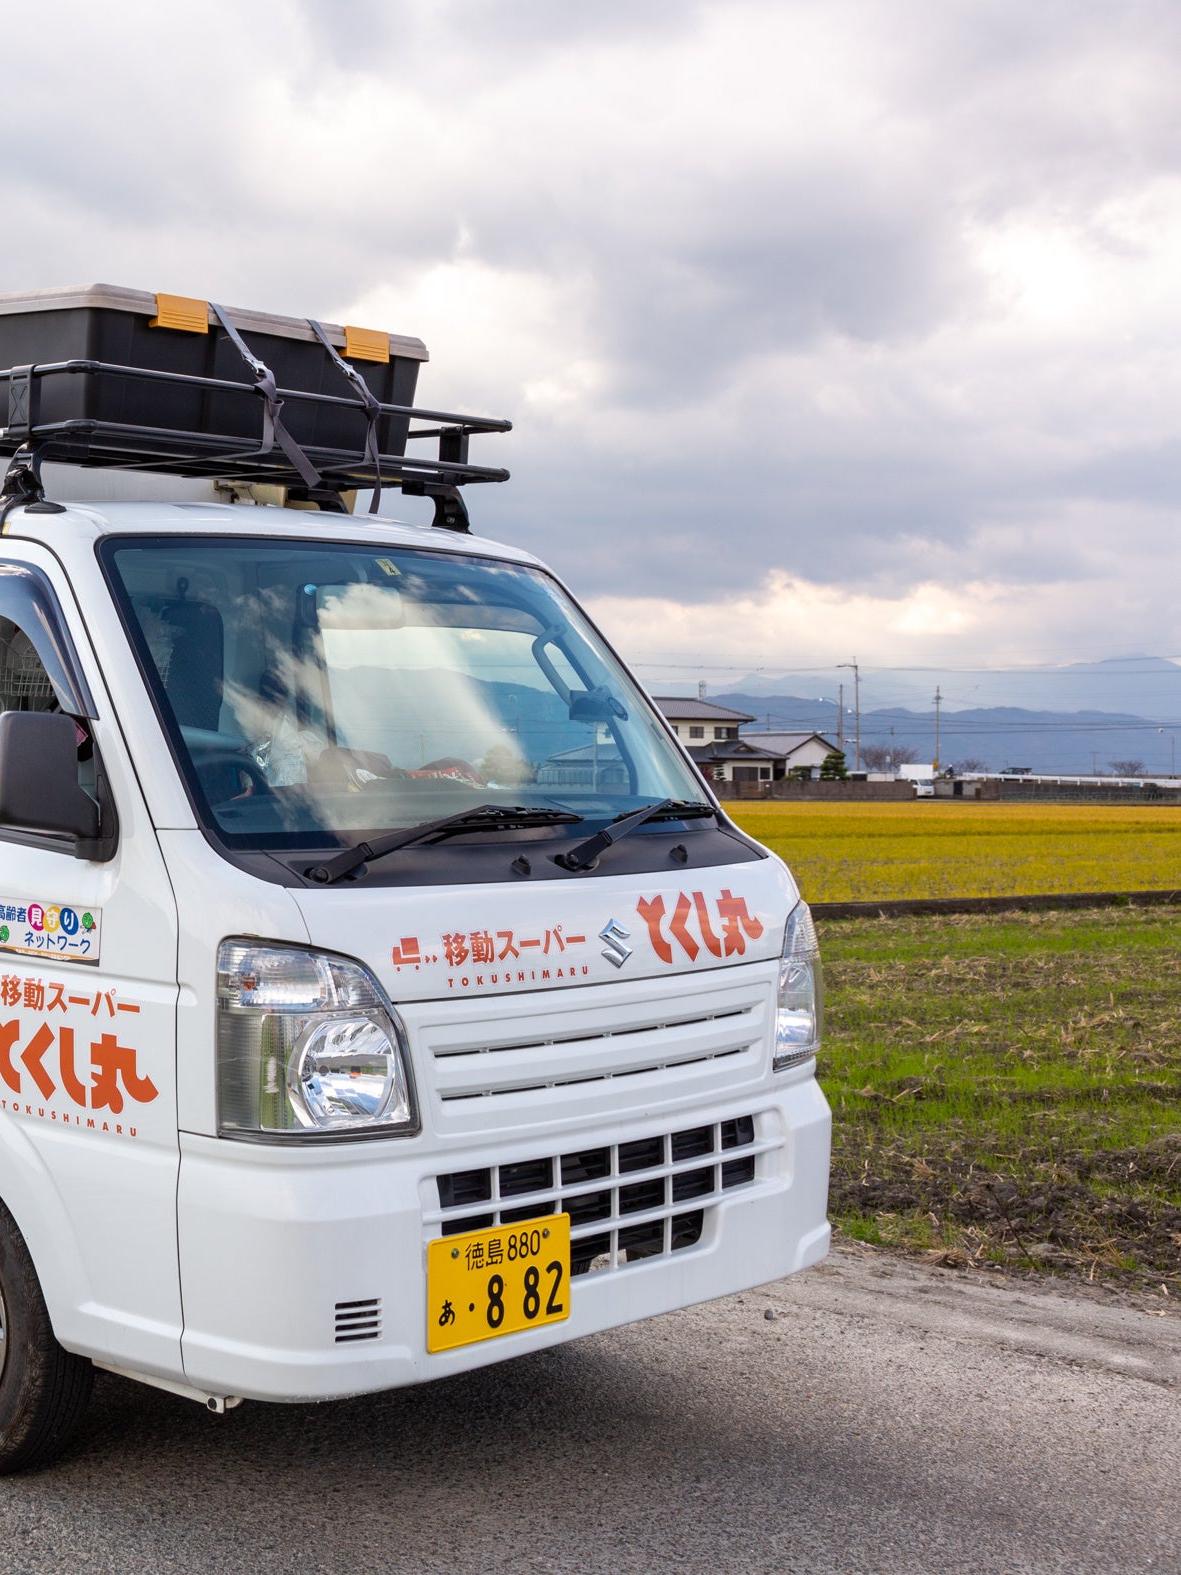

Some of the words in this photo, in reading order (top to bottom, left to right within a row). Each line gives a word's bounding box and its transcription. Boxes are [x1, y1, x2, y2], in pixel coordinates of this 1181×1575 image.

[24, 931, 91, 954] ネットワーク
[442, 924, 587, 967] 移動スーパー
[636, 888, 764, 964] とくし丸
[0, 973, 141, 1018] 移動スーパー
[448, 965, 589, 988] TOKUSHIMARU
[1, 1100, 138, 1138] TOKUSHIMARU
[465, 1238, 504, 1271] 徳島
[507, 1229, 541, 1262] 880
[438, 1299, 456, 1327] あ
